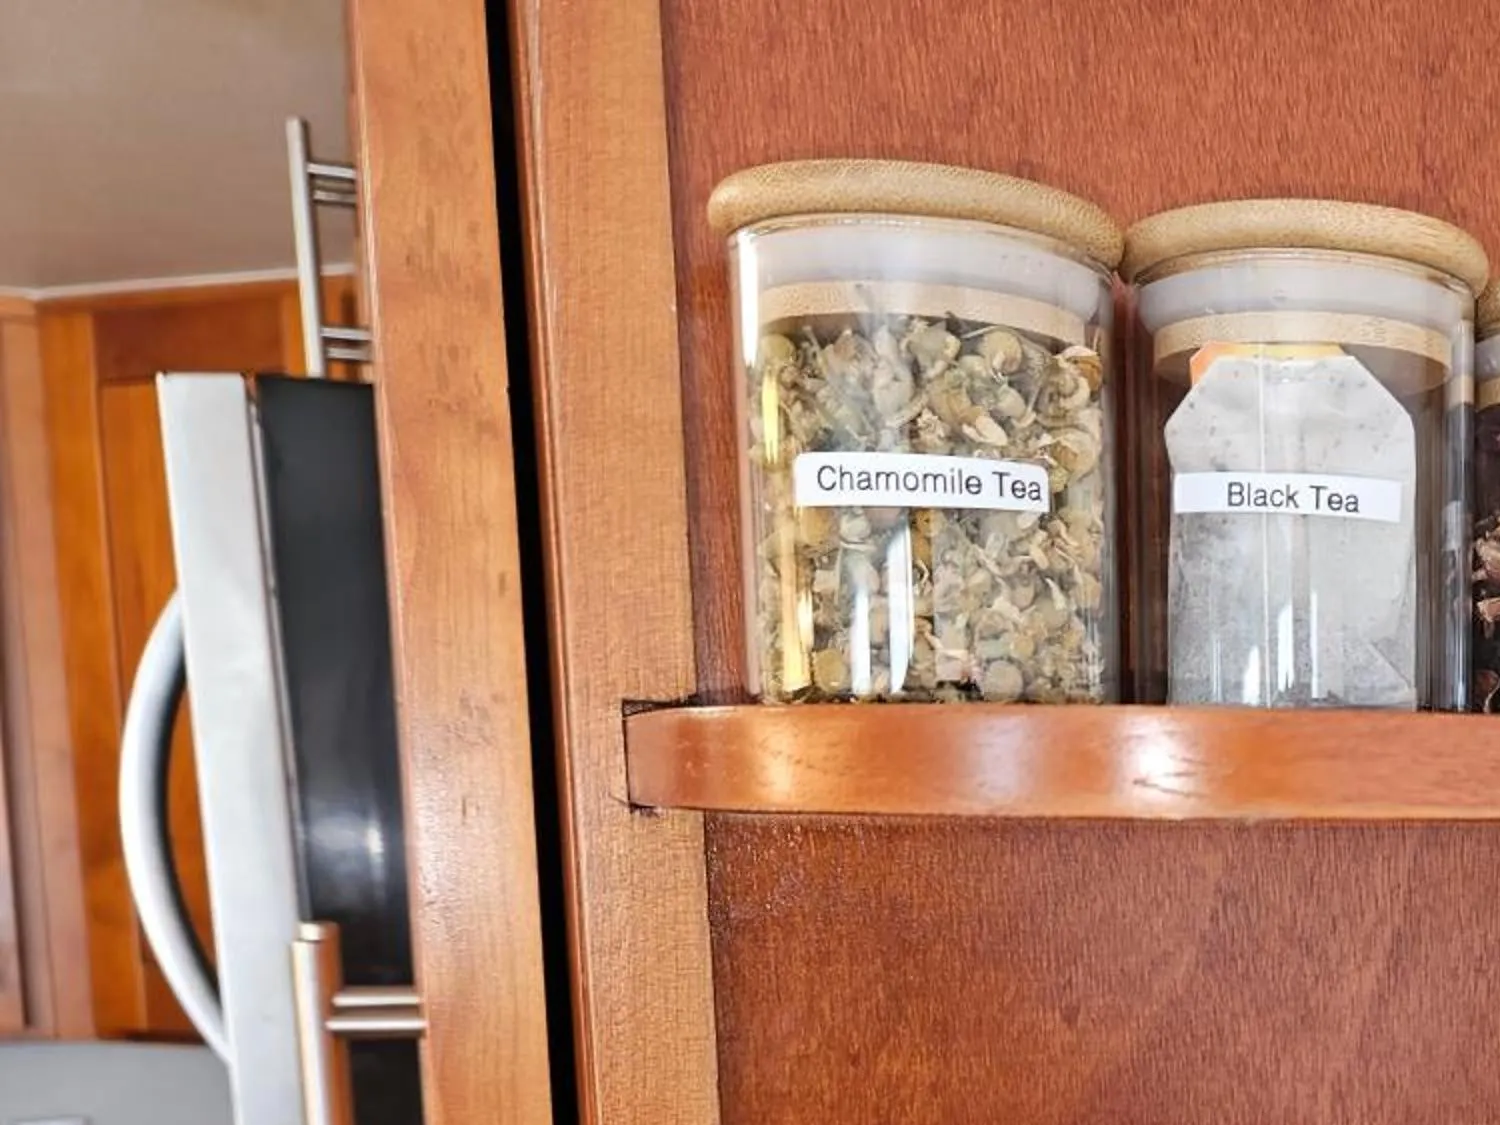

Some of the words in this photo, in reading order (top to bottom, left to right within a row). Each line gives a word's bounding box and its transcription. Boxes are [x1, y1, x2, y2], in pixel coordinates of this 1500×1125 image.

[816, 464, 983, 496] Chamomile
[992, 471, 1042, 501] Tea
[1226, 481, 1300, 509] Black
[1309, 485, 1360, 513] Tea
